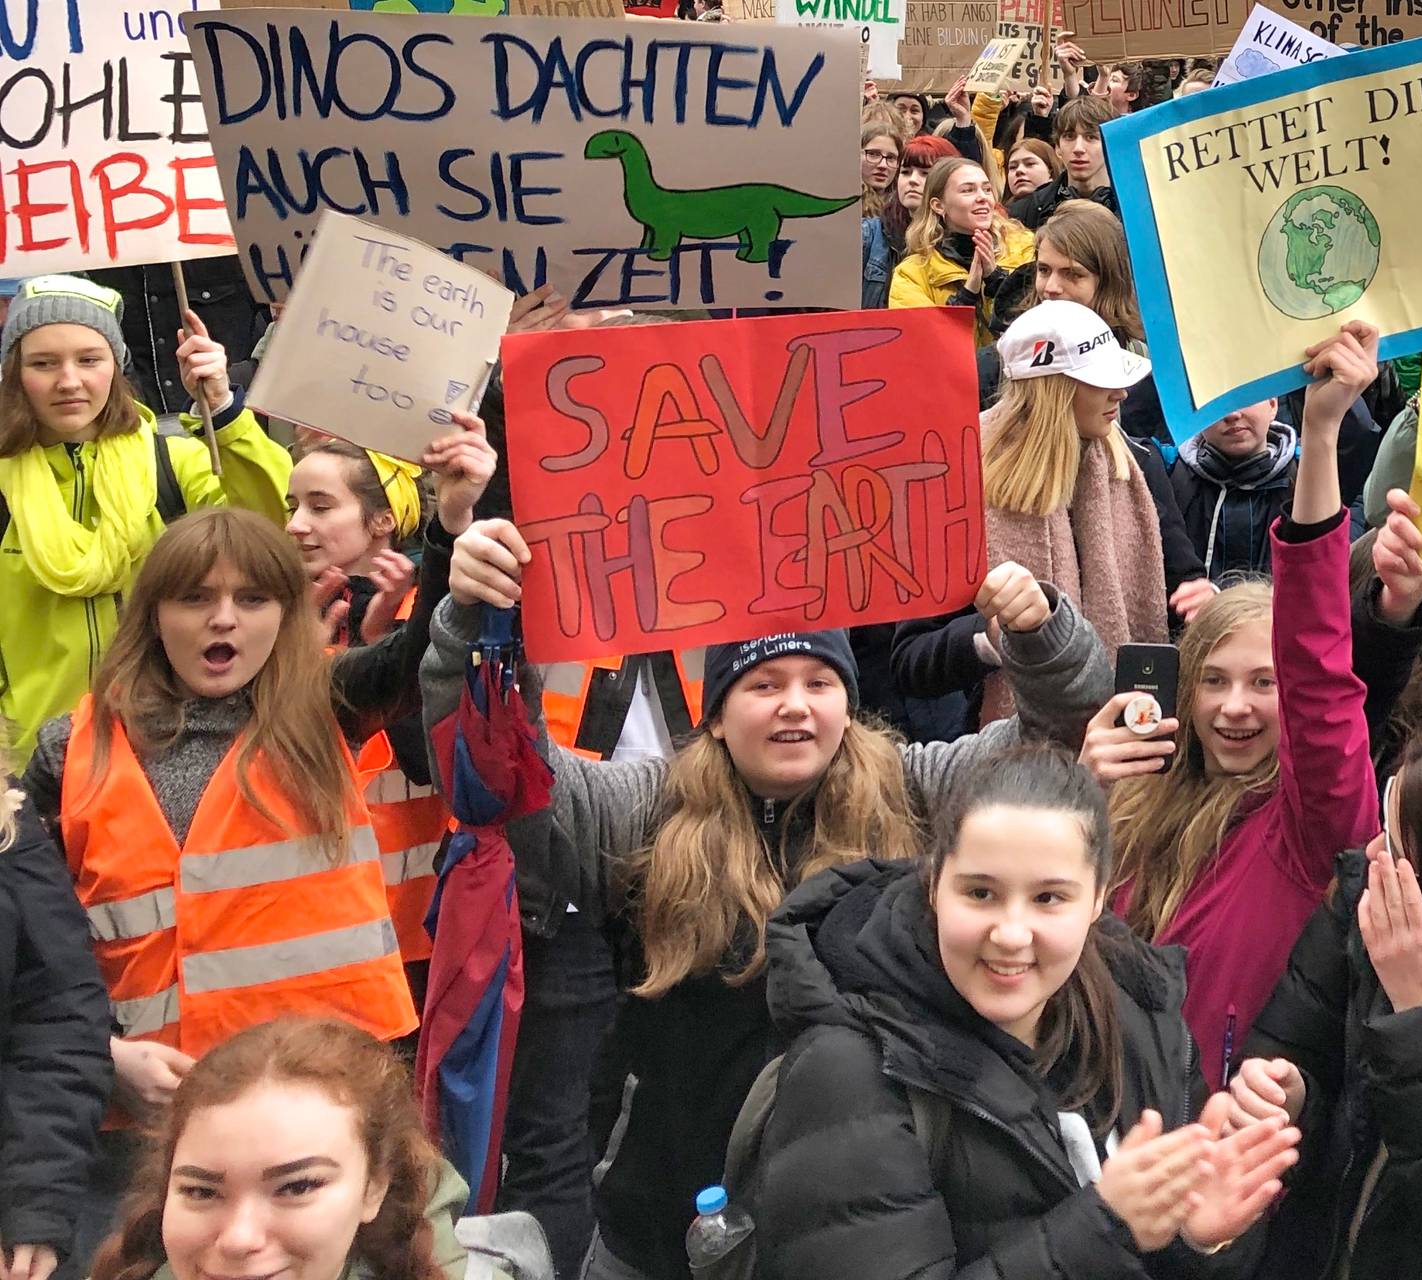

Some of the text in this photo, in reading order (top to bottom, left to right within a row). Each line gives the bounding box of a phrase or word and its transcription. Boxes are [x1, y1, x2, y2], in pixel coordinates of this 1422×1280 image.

[998, 23, 1021, 39] ITS
[1309, 13, 1404, 46] of the
[194, 20, 825, 129] DINOS DACHTEN
[1163, 96, 1334, 182] RETTET
[1245, 133, 1392, 194] WELT!
[236, 144, 565, 226] AUCH SIE
[353, 234, 413, 282] The
[422, 271, 486, 319] earth
[316, 308, 412, 363] house
[372, 281, 464, 339] is our
[351, 364, 415, 412] too
[539, 327, 905, 481] SAVE
[521, 426, 983, 641] THE EARTH
[732, 640, 812, 672] Blue Liners
